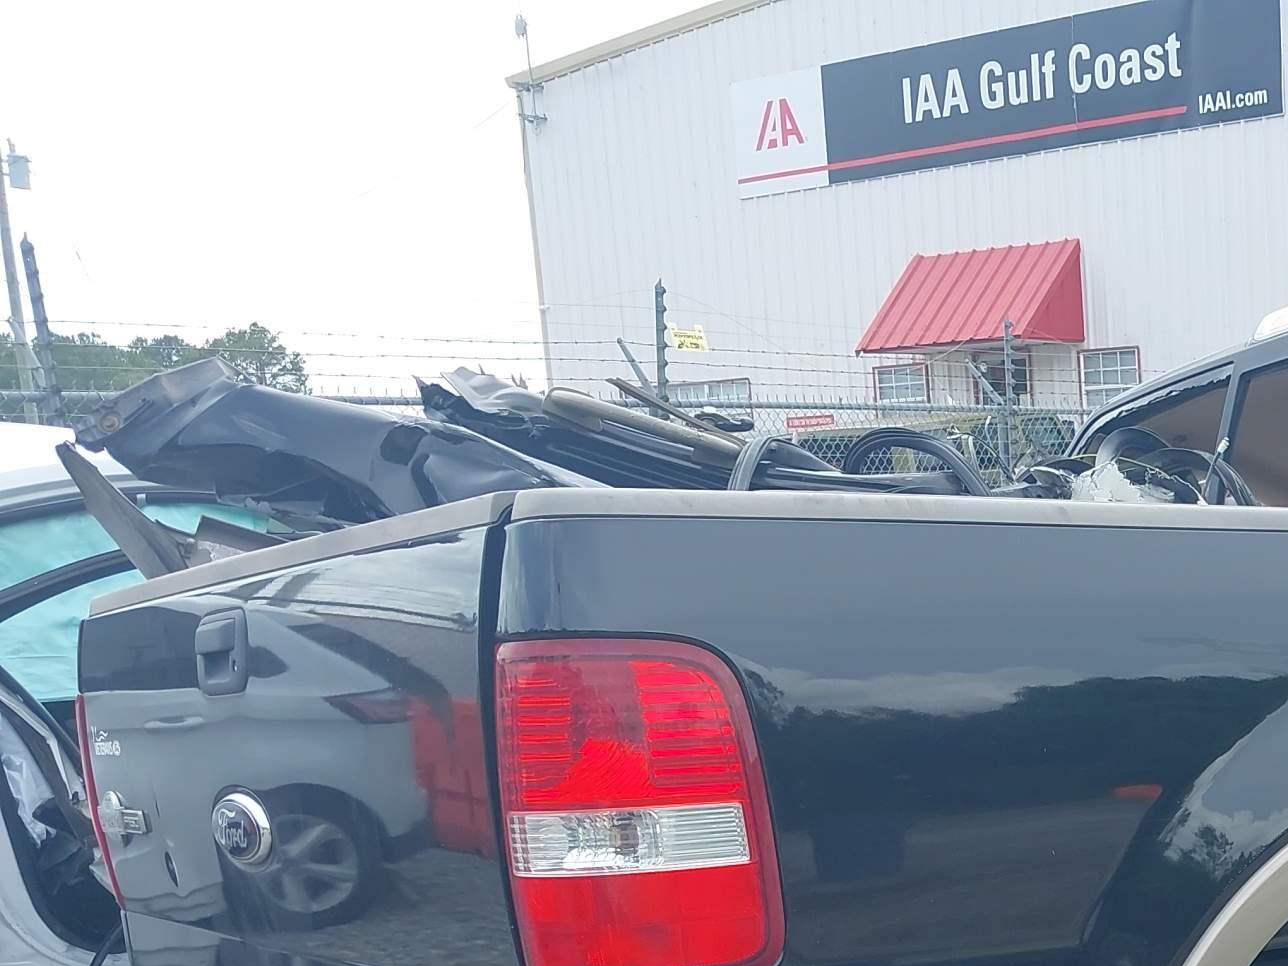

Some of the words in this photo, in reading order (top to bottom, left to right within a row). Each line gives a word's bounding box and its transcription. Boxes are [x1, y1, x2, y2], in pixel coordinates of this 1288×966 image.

[902, 67, 969, 124] IAA
[979, 49, 1056, 110] Gulf
[1067, 31, 1182, 95] Coast
[1197, 87, 1269, 115] IAAI.com
